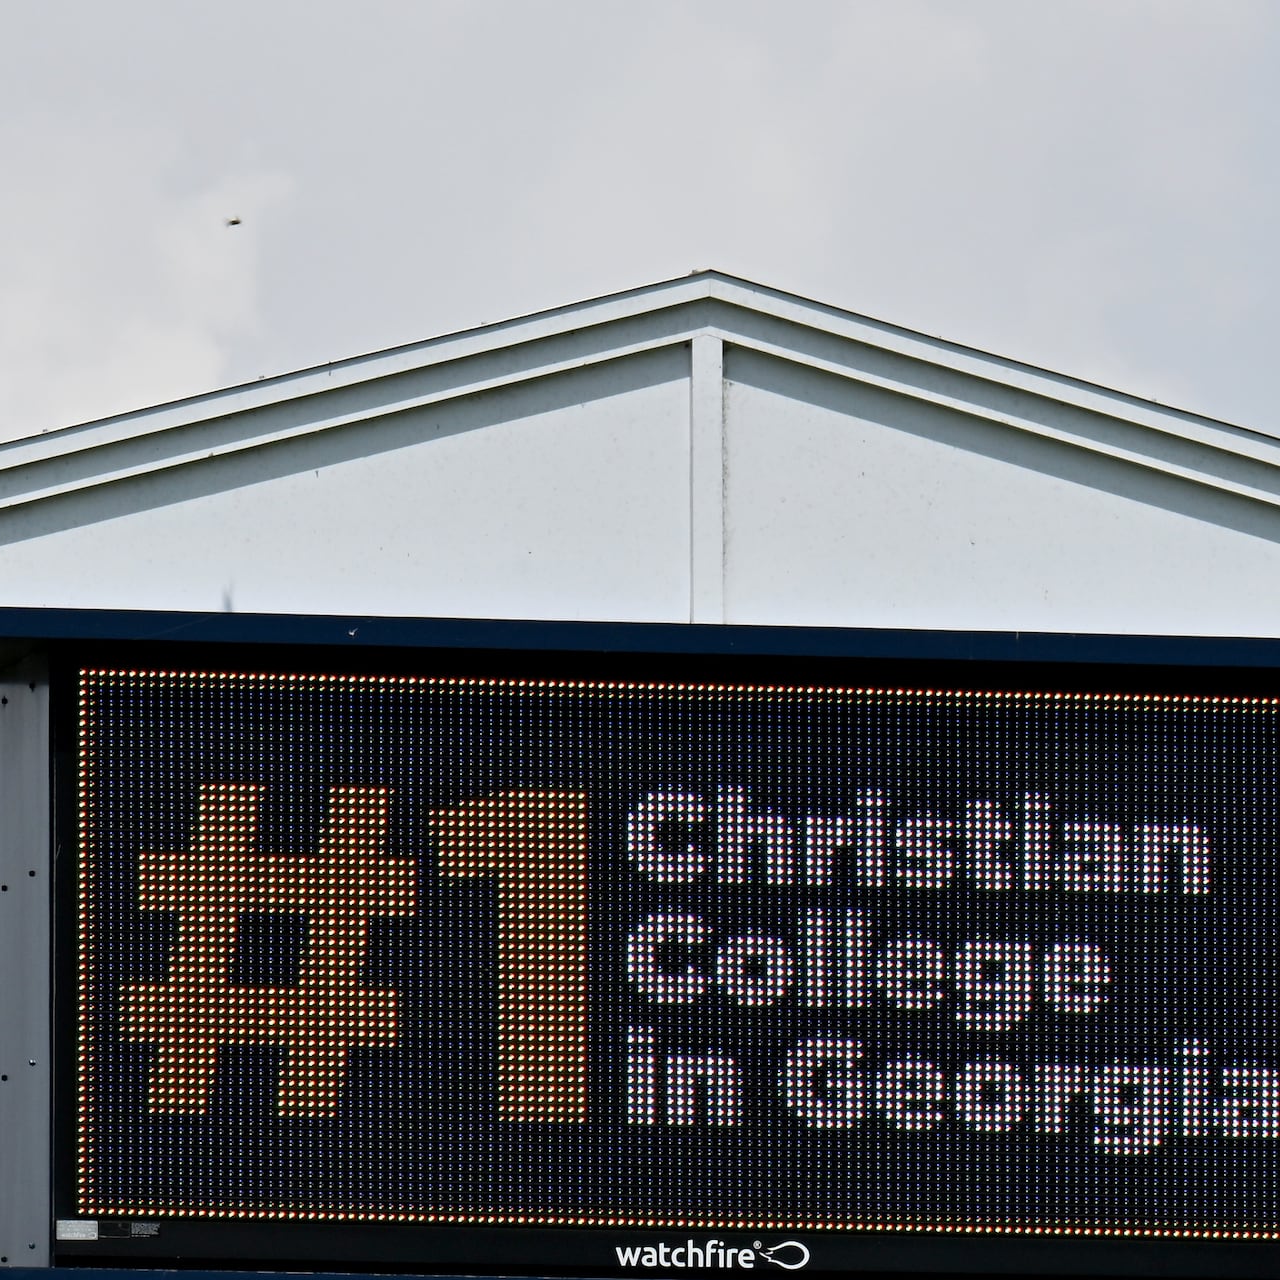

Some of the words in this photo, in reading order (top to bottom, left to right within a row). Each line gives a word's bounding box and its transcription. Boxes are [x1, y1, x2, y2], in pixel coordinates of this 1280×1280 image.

[626, 787, 1212, 894] Christian
[120, 783, 588, 1123] #1
[626, 909, 1110, 1032] College
[626, 1023, 742, 1127] in
